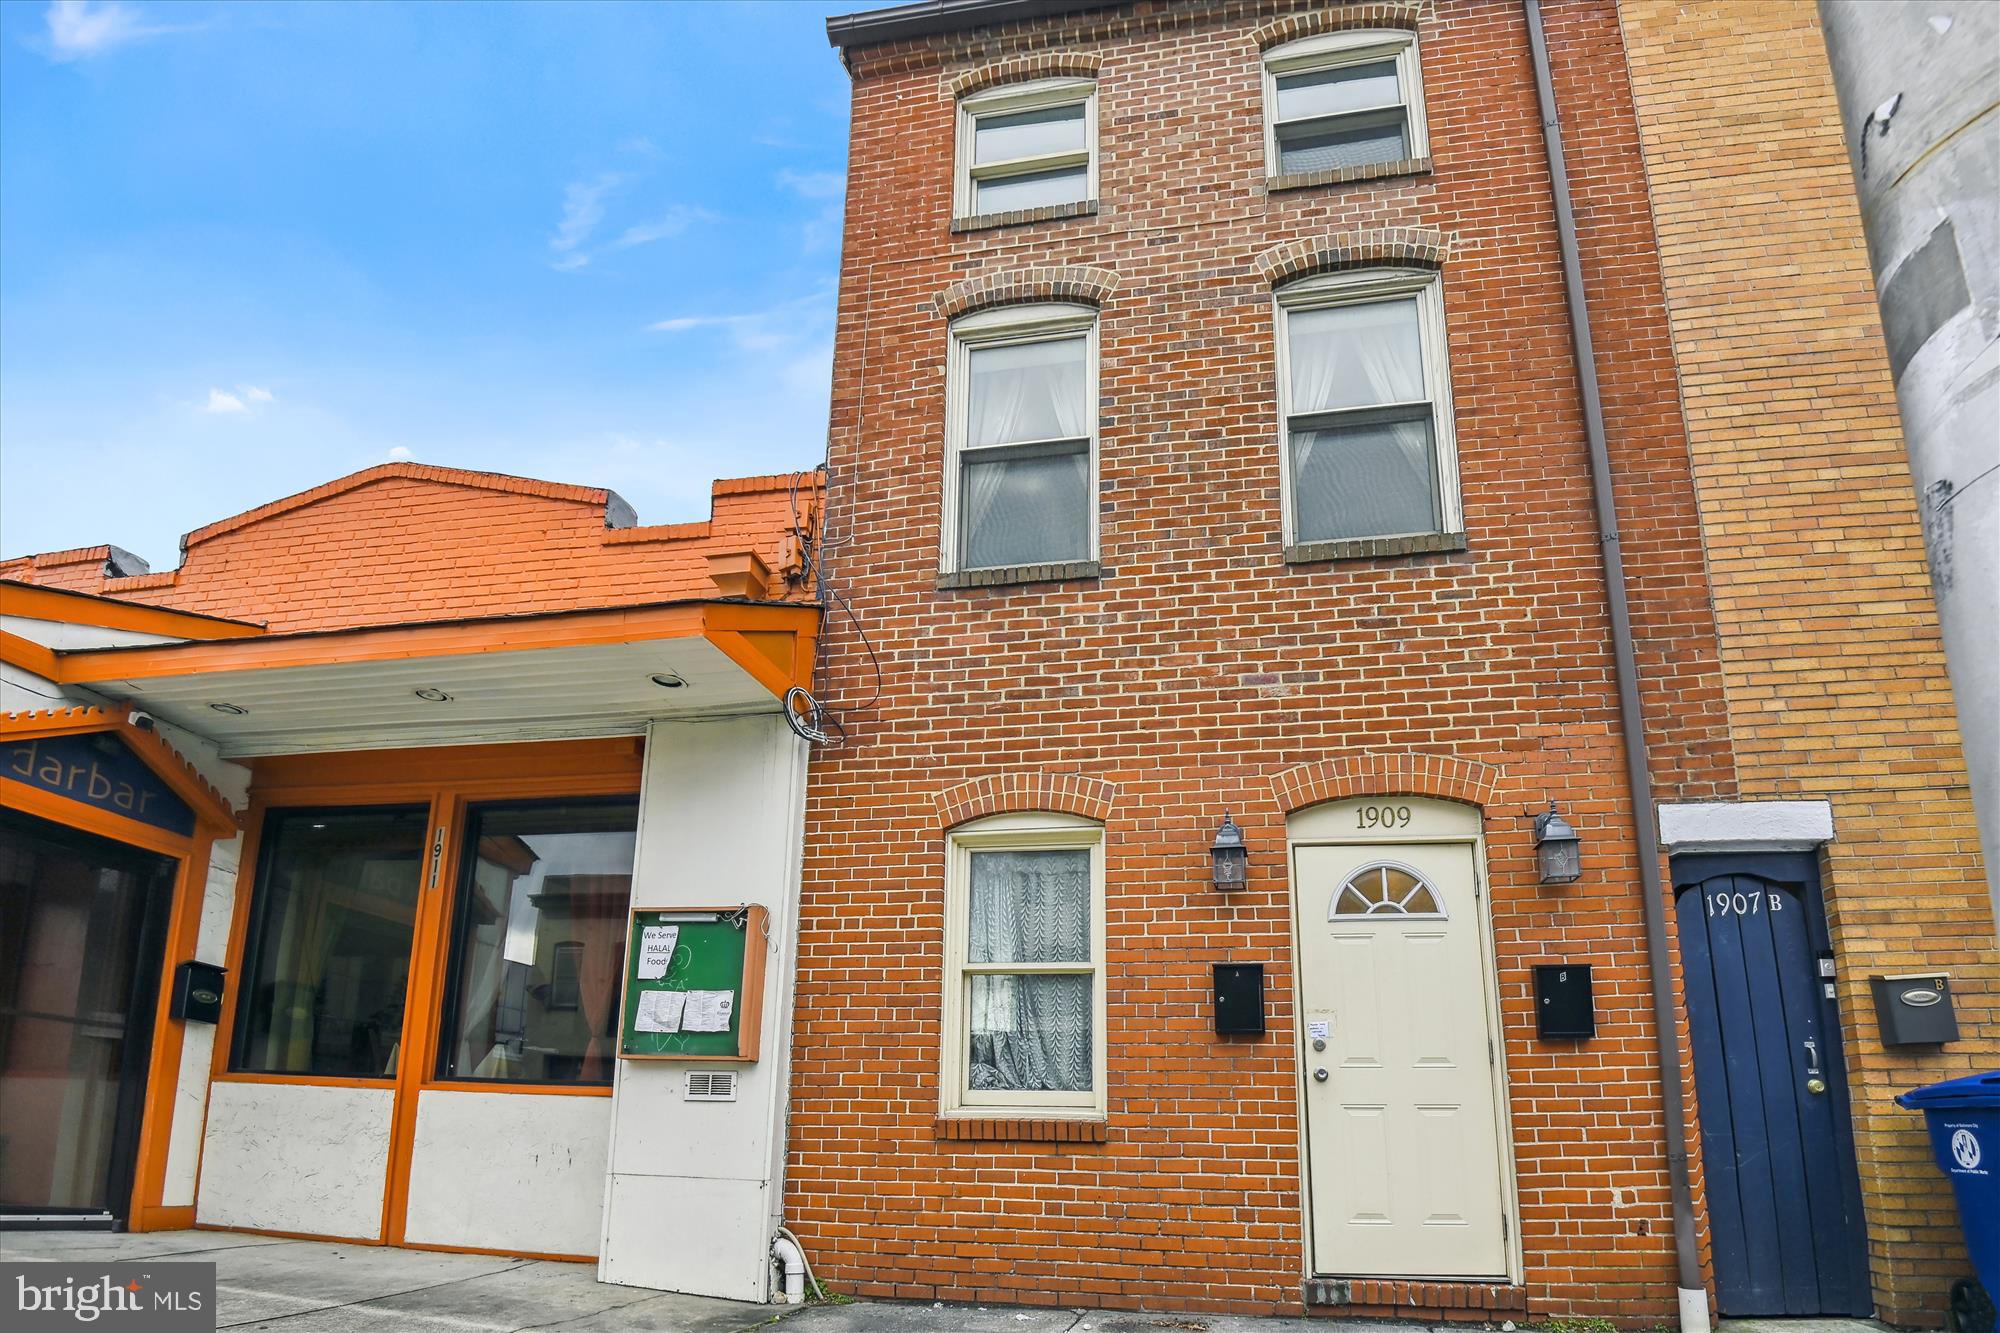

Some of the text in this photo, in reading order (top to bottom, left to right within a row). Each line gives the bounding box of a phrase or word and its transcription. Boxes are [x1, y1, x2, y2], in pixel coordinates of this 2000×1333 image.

[1356, 806, 1412, 829] 1909
[431, 828, 442, 889] 1911
[1706, 891, 1783, 917] 1907 B
[643, 931, 677, 939] We Serve
[647, 944, 670, 952] HALAL
[1935, 979, 1944, 991] B
